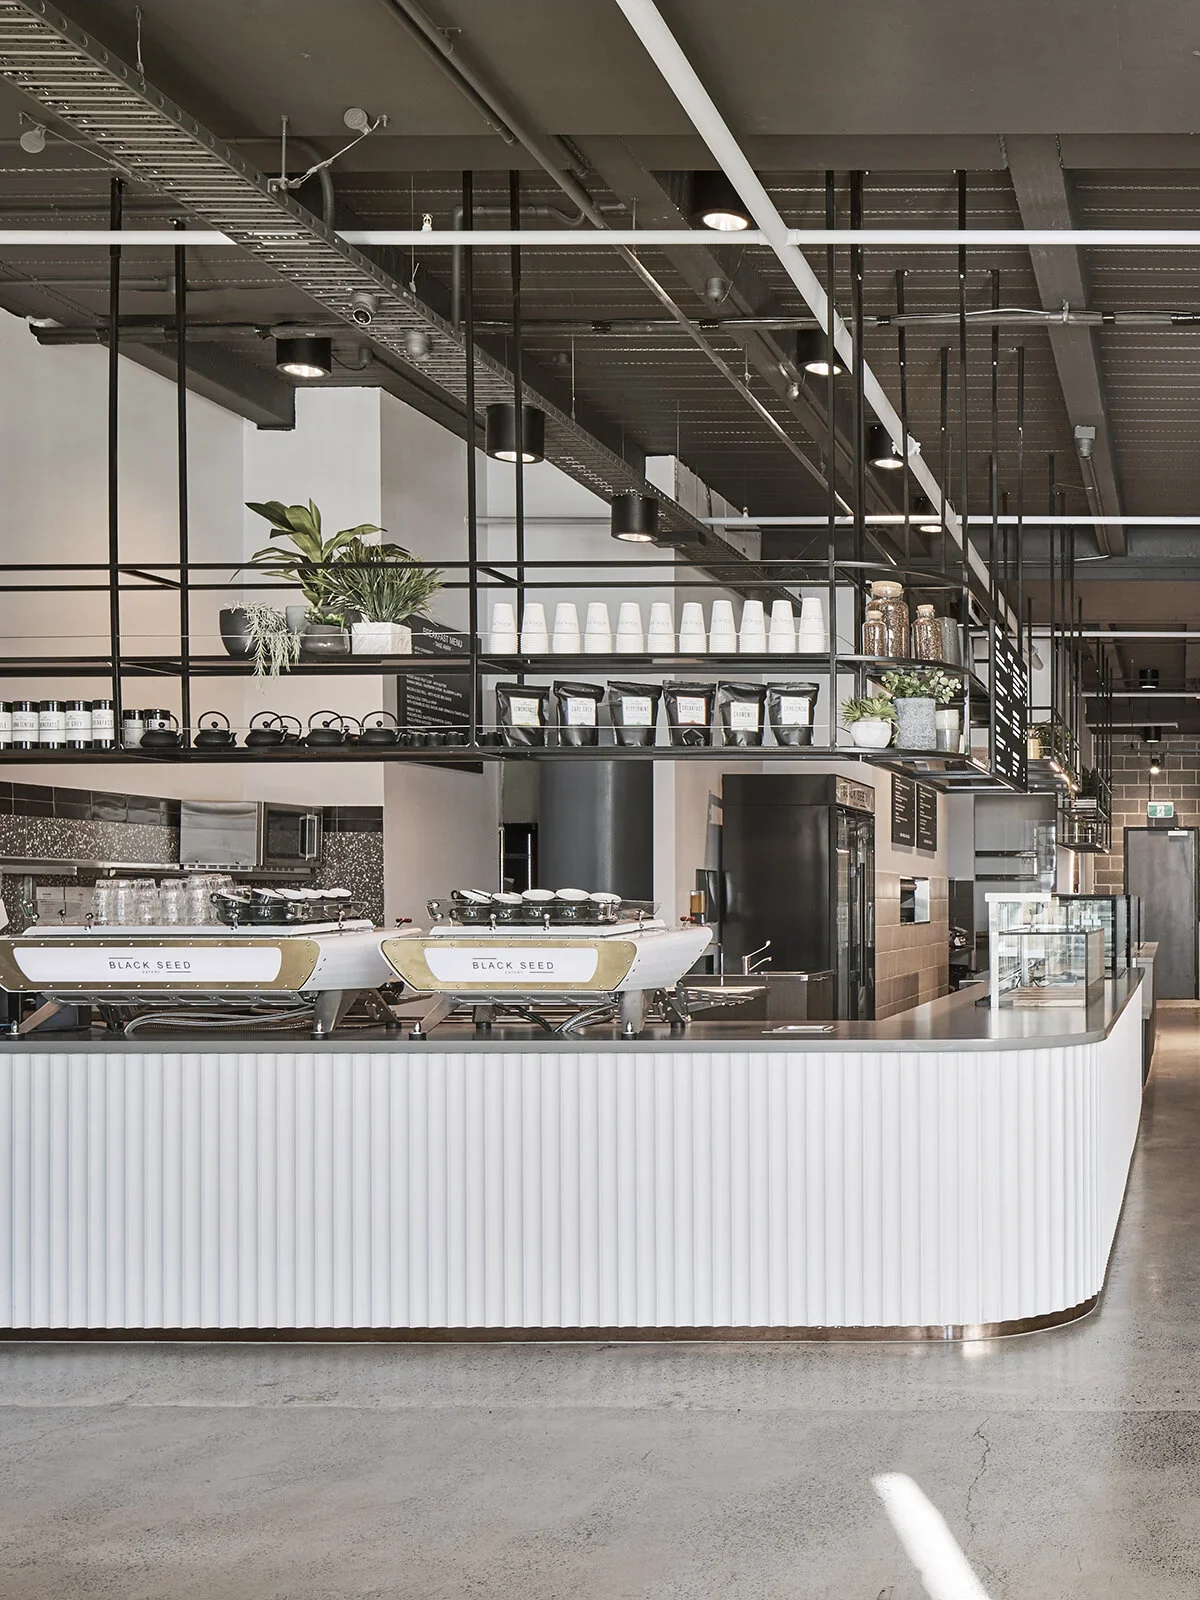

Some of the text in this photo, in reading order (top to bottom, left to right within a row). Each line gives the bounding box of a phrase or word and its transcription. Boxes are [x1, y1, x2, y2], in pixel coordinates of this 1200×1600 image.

[423, 627, 463, 648] BREAKFAST MENU
[682, 704, 703, 712] BREAKFAST
[109, 961, 191, 969] BLACK SEED
[472, 961, 554, 970] BLACK SEED
